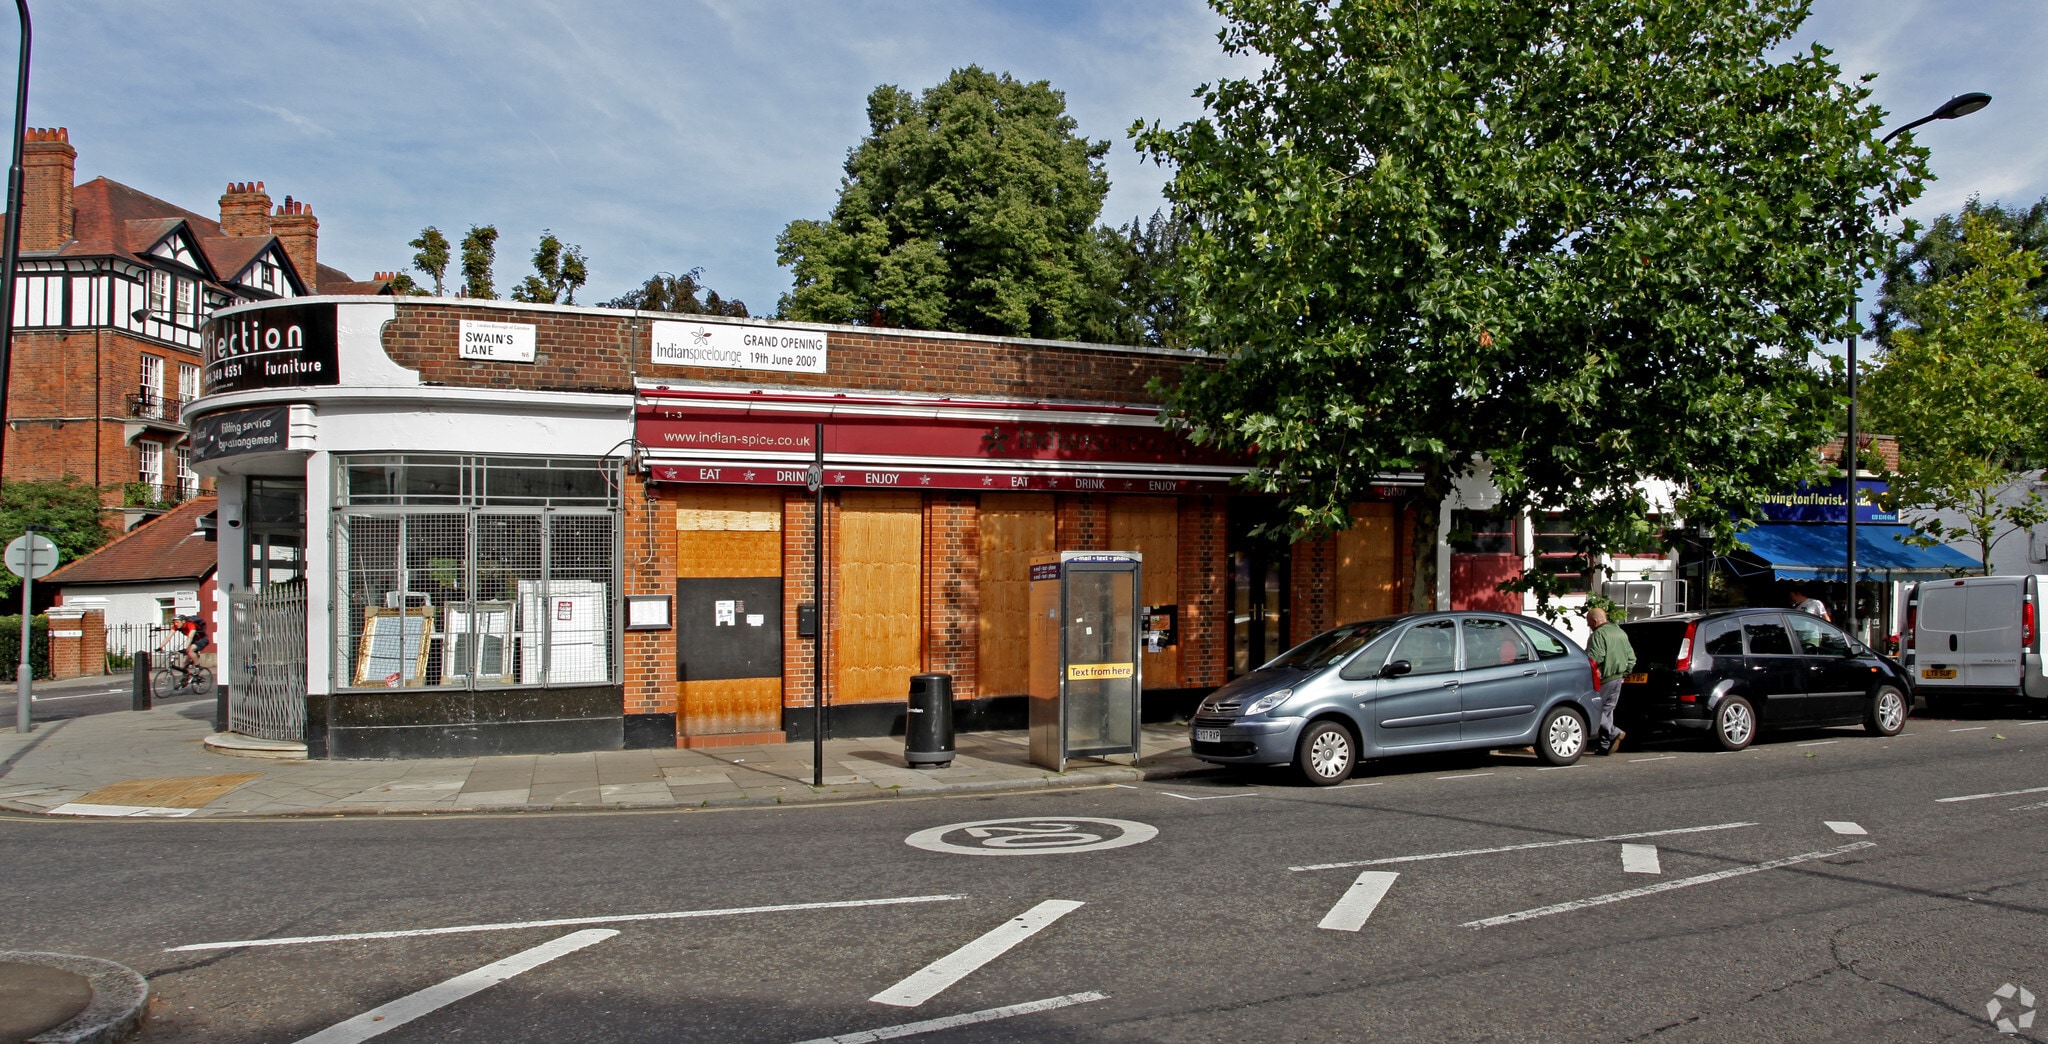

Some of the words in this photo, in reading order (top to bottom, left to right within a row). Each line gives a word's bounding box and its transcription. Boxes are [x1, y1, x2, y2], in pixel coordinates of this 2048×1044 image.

[465, 332, 513, 345] SWAIN'S
[743, 334, 778, 348] GRAND
[780, 337, 823, 351] OPENING
[465, 344, 494, 356] LANE
[656, 342, 742, 366] Indianspicelounge
[265, 358, 322, 376] furniture
[749, 351, 769, 365] 19th
[771, 353, 794, 366] June
[795, 355, 817, 368] 2009
[224, 363, 242, 380] 4551
[242, 419, 272, 431] service
[664, 431, 811, 447] www.indian-spice.co.uk
[699, 469, 721, 480] EAT
[776, 470, 808, 482] DRIN
[865, 473, 900, 484] ENJOY
[1011, 476, 1030, 488] EAT
[1075, 479, 1106, 489] DRINK
[1149, 481, 1177, 491] ENJOY
[1383, 487, 1407, 496] ENJOY
[808, 472, 819, 486] 20
[1071, 667, 1089, 676] Text
[1090, 667, 1111, 676] from
[1112, 666, 1131, 675] here
